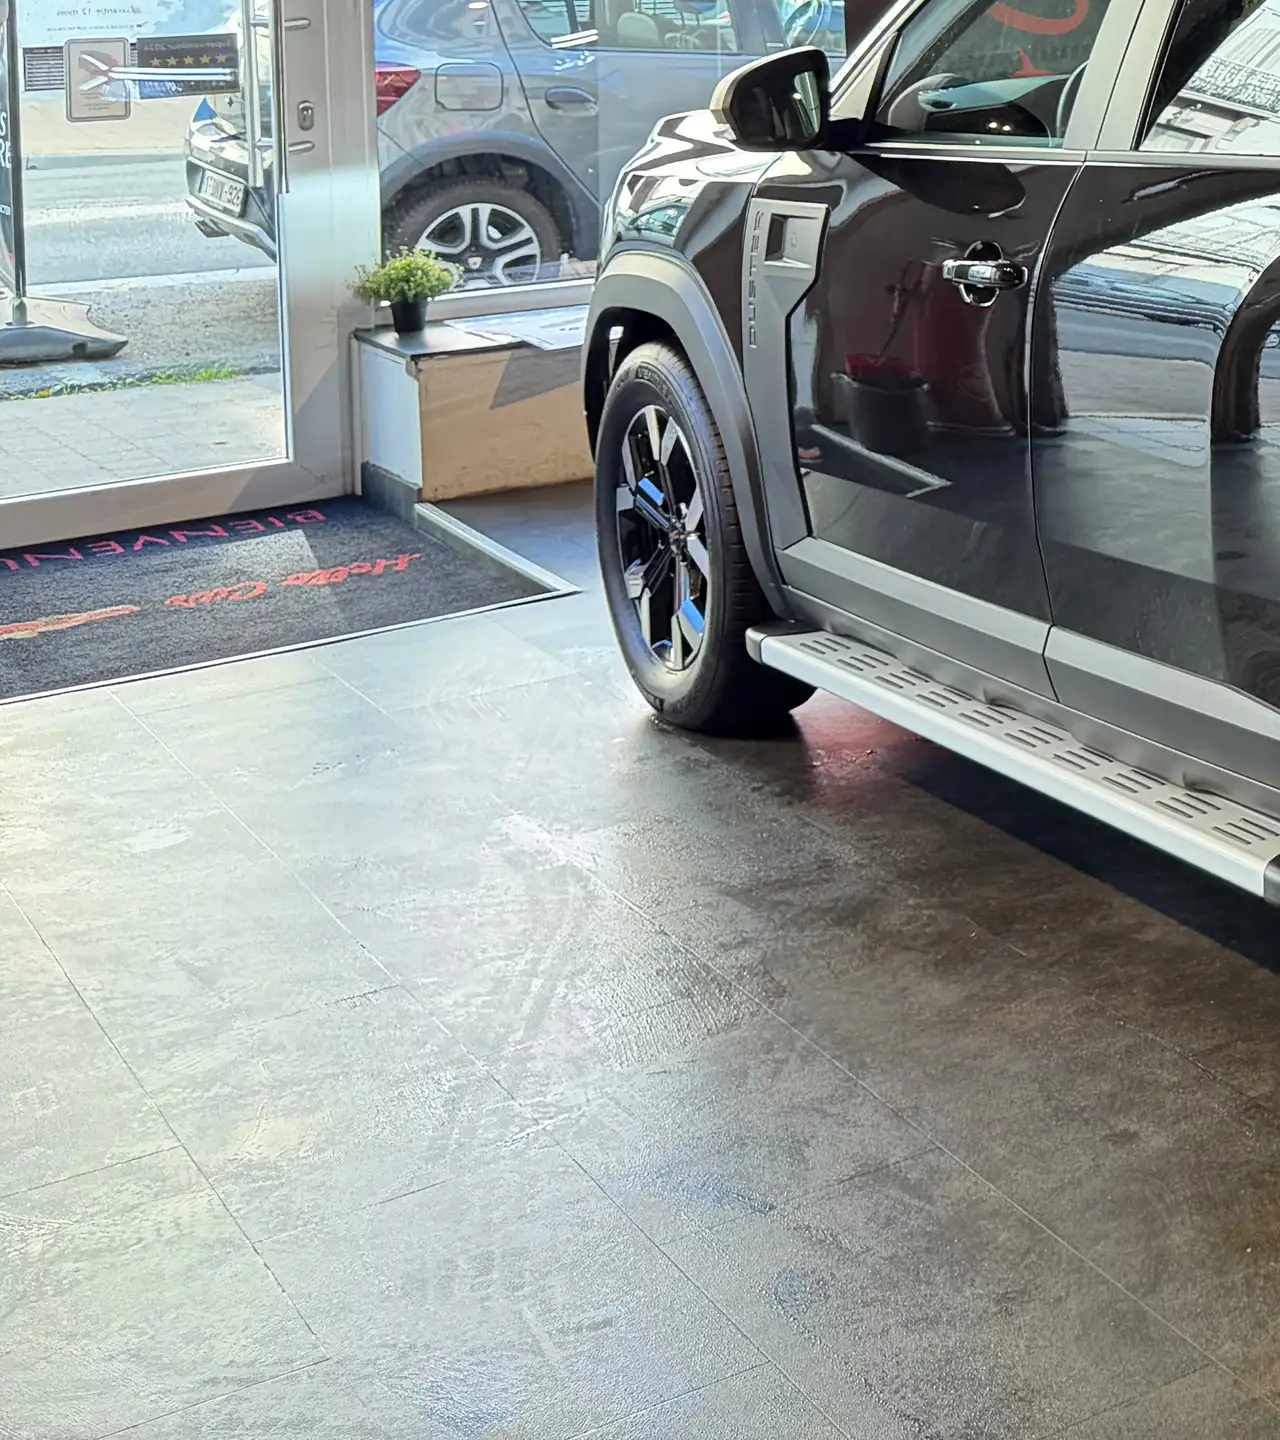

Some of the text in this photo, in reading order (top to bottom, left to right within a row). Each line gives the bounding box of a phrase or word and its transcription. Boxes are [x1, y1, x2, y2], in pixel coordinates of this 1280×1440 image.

[748, 210, 764, 349] DUSTER
[164, 552, 422, 609] Hello Car
